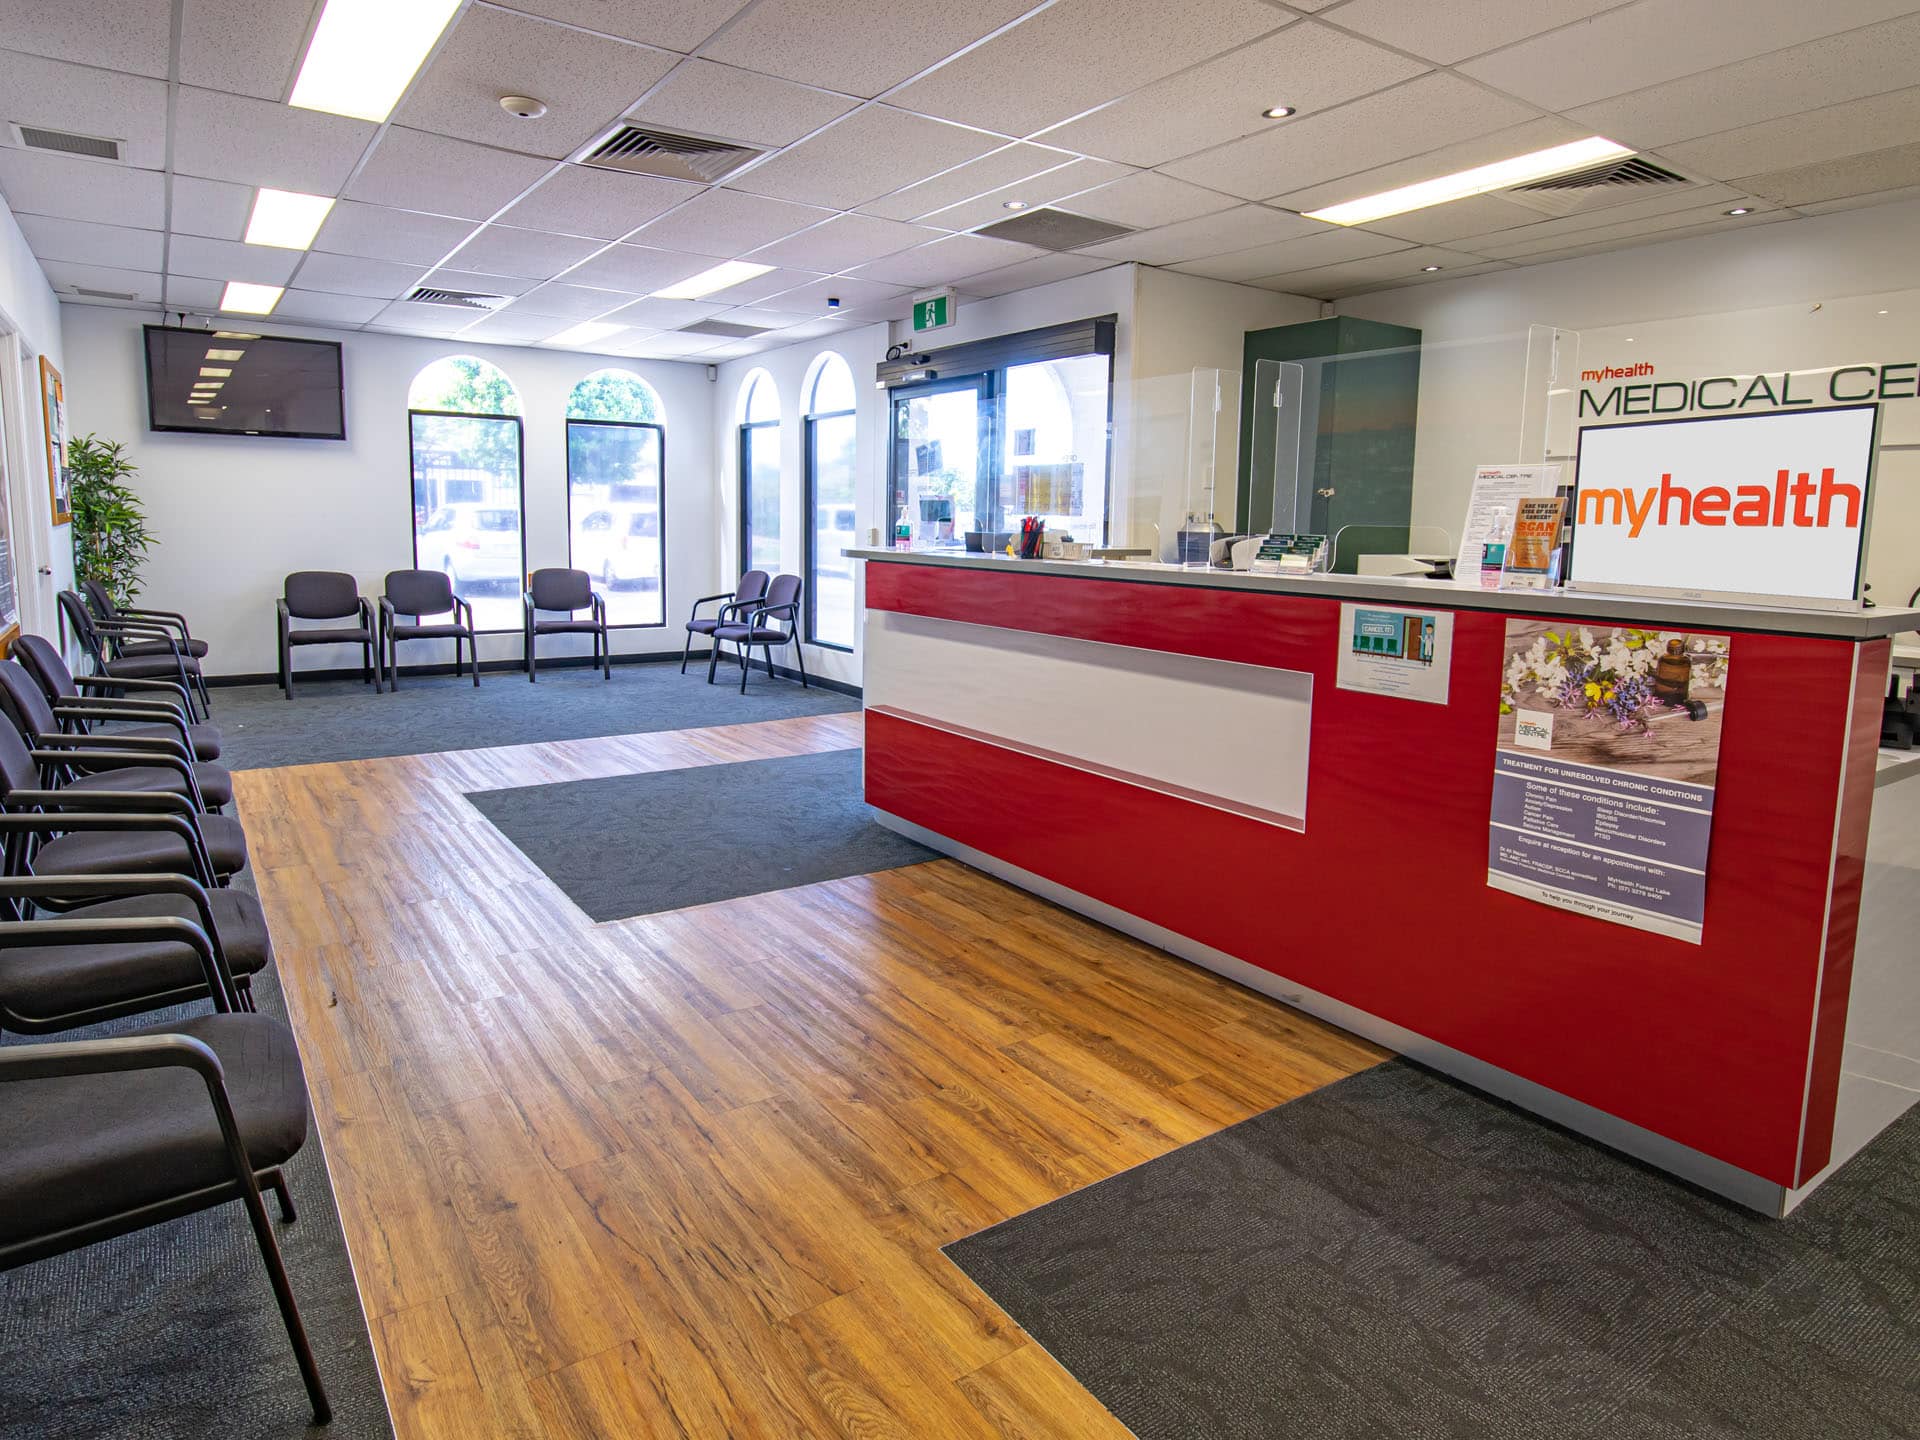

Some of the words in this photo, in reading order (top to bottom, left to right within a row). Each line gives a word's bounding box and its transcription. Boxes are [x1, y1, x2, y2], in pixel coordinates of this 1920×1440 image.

[1581, 362, 1654, 383] myhealth
[1578, 373, 1813, 418] MEDICAL
[1829, 362, 1920, 401] CE
[1577, 468, 1862, 538] myhealth
[1519, 522, 1556, 532] SCAN
[1519, 724, 1549, 735] MEDICAL
[1502, 758, 1543, 772] TREATMENT
[1544, 766, 1560, 775] FOR
[1560, 769, 1611, 785] UNRESOLVED
[1612, 779, 1649, 792] CHRONIC
[1650, 786, 1703, 802] CONDITIONS
[1526, 781, 1548, 793] Some
[1549, 786, 1558, 794] of
[1558, 788, 1581, 800] these
[1582, 793, 1624, 808] conditions
[1625, 801, 1660, 815] include:
[1637, 834, 1667, 847] Disorders
[1518, 835, 1542, 847] Enquire
[1550, 844, 1581, 857] reception
[1581, 850, 1592, 859] for
[1602, 857, 1647, 873] appointment
[1647, 867, 1667, 877] with:
[1635, 882, 1655, 892] Forest
[1655, 887, 1671, 896] Lake
[1549, 893, 1562, 903] help
[1574, 900, 1597, 911] through
[1597, 906, 1611, 914] your
[1611, 909, 1634, 921] journey
